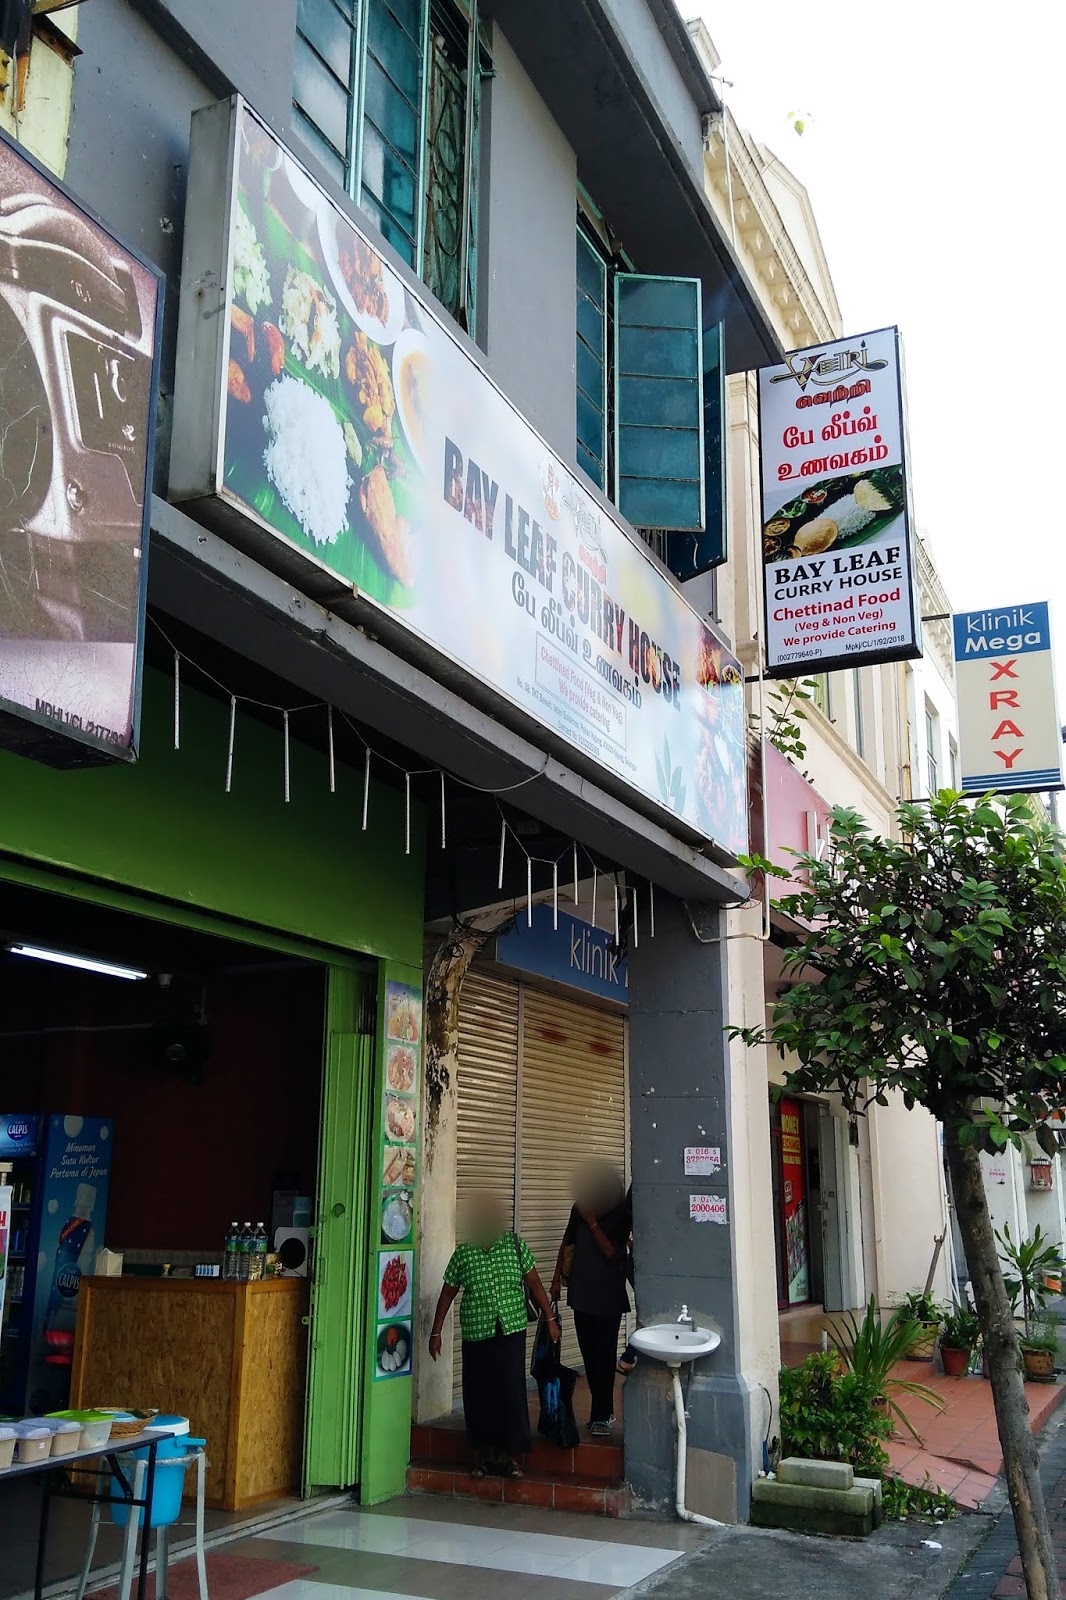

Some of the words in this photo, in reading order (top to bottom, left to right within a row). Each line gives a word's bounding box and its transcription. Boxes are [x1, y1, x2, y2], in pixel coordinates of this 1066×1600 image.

[796, 379, 871, 408] வெற்றி
[783, 426, 815, 448] பே
[821, 406, 878, 441] லீப்வ்
[778, 434, 888, 481] உணவகம்
[444, 436, 499, 541] BAY
[504, 493, 557, 593] LEAF
[561, 551, 625, 656] CURRY
[629, 617, 681, 712] HOUSE
[774, 561, 826, 585] BAY
[833, 547, 900, 574] LEAF
[774, 580, 833, 600] CURRY
[840, 567, 902, 589] HOUSE
[773, 596, 854, 621] Chettinad
[858, 587, 900, 607] Food
[783, 636, 800, 646] We
[803, 629, 845, 645] provide
[847, 621, 896, 635] Catering
[794, 622, 819, 632] (Veg
[822, 618, 830, 627] &
[833, 615, 855, 625] Non
[858, 608, 883, 622] Veg)
[966, 608, 1034, 633] klinik
[512, 571, 536, 620] பே
[583, 638, 642, 709] உணவகம்
[964, 631, 1041, 653] Mega
[541, 645, 570, 680] Chettinad
[570, 668, 584, 691] Food
[601, 694, 612, 713] Non
[558, 679, 568, 697] We
[568, 688, 589, 713] provide
[589, 703, 611, 733] catering
[8, 1124, 28, 1134] CALPIS
[61, 1155, 76, 1165] Susu
[65, 1142, 96, 1152] Minuman
[50, 1168, 78, 1178] Pertama
[81, 1167, 88, 1176] di
[691, 1203, 725, 1213] 2000406
[58, 1273, 80, 1290] CALPIS
